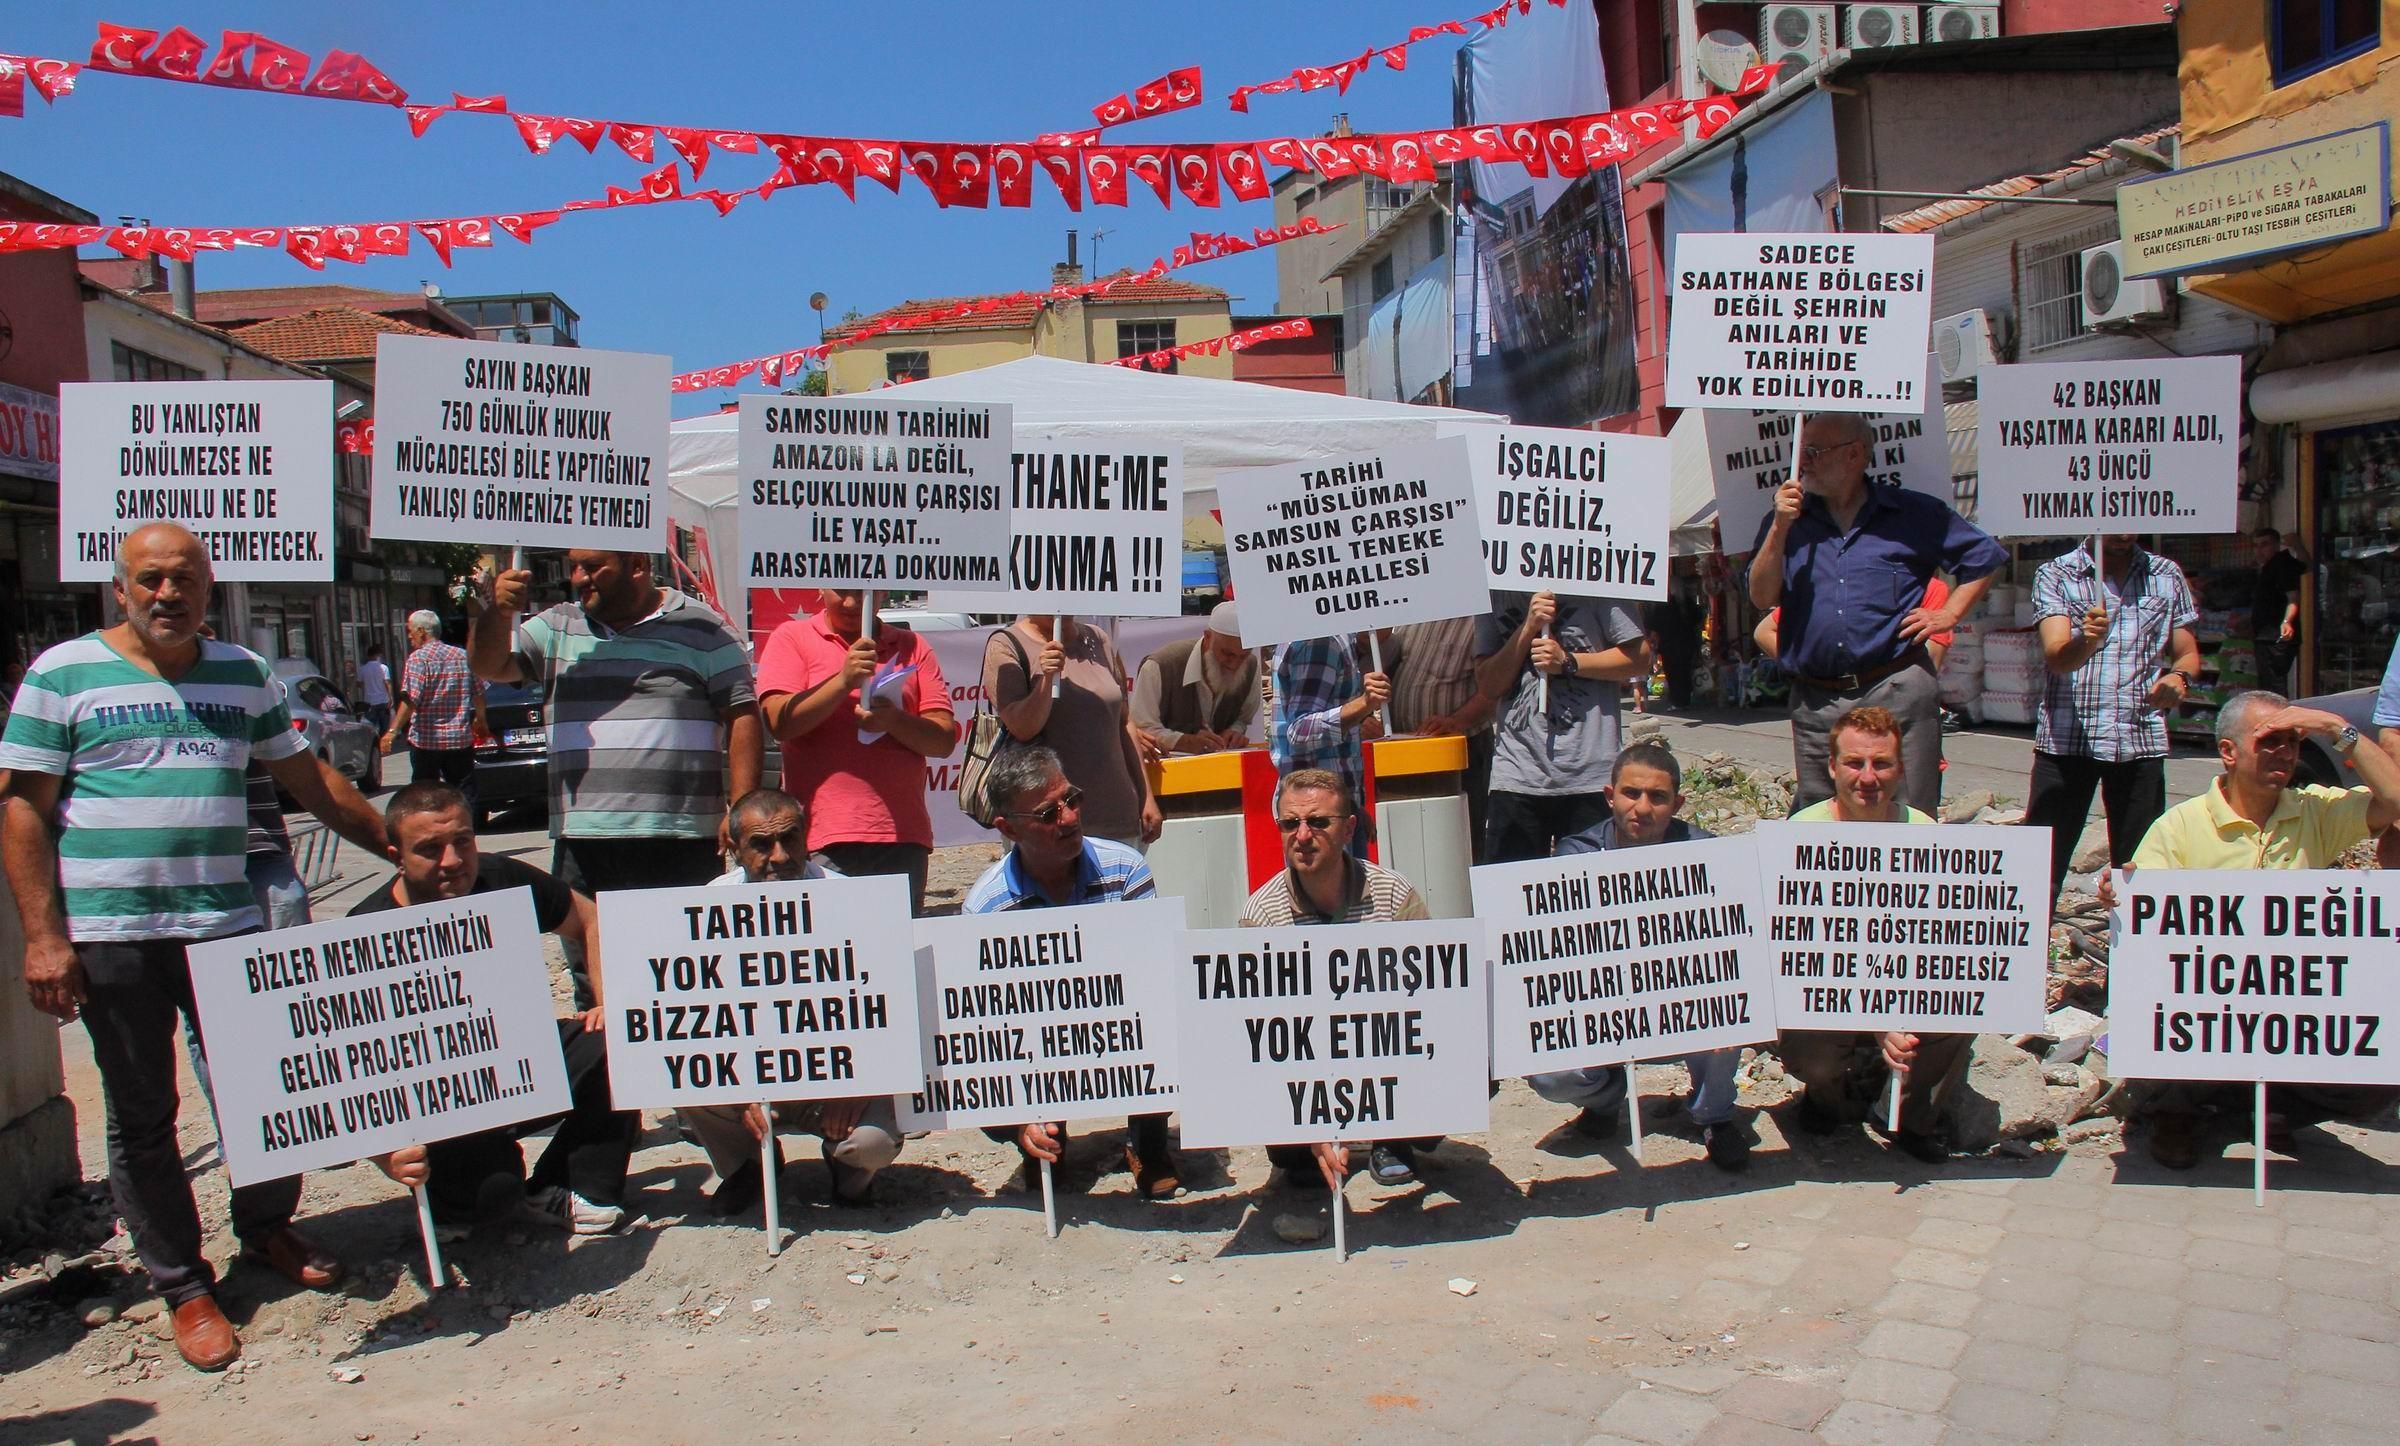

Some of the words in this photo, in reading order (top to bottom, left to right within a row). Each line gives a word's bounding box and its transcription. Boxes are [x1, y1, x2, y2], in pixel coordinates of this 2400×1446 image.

[2134, 229, 2163, 243] HESAP
[2251, 208, 2262, 219] ve
[2304, 184, 2367, 207] TABAKALARI
[1759, 245, 1855, 265] SADECE
[2143, 244, 2165, 259] ÇAKI
[2241, 224, 2263, 237] TAŞI
[1681, 271, 1809, 291] SAATHANE
[1818, 268, 1924, 292] BÖLGESİ
[1714, 293, 1784, 317] DEĞİL
[1793, 294, 1886, 320] ŞEHRİN
[1727, 323, 1828, 344] ANILARI
[1839, 325, 1868, 345] VE
[464, 357, 516, 392] SAYIN
[522, 362, 591, 398] BAŞKAN
[1744, 347, 1857, 372] TARİHİDE
[1697, 376, 1743, 396] YOK
[1752, 373, 1912, 401] EDİLİYOR...!!
[2053, 381, 2076, 408] 42
[2084, 378, 2161, 410] BAŞKAN
[132, 404, 155, 435] BU
[161, 402, 260, 437] YANLIŞTAN
[441, 400, 473, 432] 750
[479, 397, 549, 437] GÜNLÜK
[554, 407, 612, 442] HUKUK
[765, 406, 889, 436] SAMSUNUN
[896, 406, 990, 439] TARİHİNİ
[1999, 418, 2087, 450] YAŞATMA
[2095, 416, 2165, 444] KARARI
[2172, 414, 2223, 445] ALDI,
[120, 440, 241, 477] DÖNÜLMEZSE
[248, 445, 273, 476] NE
[396, 435, 507, 478] MÜCADELESİ
[513, 442, 551, 480] BİLE
[557, 448, 651, 487] YAPTIĞINIZ
[773, 443, 864, 472] AMAZON
[907, 442, 974, 478] DEĞİL,
[1300, 457, 1384, 491] TARİHİ
[1497, 433, 1606, 483] İŞGALCİ
[1726, 441, 1782, 471] MİLLİ
[1885, 443, 1905, 466] Kİ
[2068, 455, 2090, 482] 43
[2098, 448, 2151, 481] ÜNCÜ
[116, 488, 215, 520] SAMSUNLU
[223, 488, 247, 519] NE
[254, 488, 277, 519] DE
[398, 484, 467, 523] YANLIŞI
[473, 483, 574, 525] GÖRMENİZE
[579, 493, 651, 530] YETMEDİ
[752, 479, 907, 510] SELÇUKLUNUN
[916, 483, 1000, 514] ÇARŞISI
[1497, 485, 1611, 538] DEĞİLİZ,
[2022, 491, 2094, 519] YIKMAK
[2101, 485, 2196, 518] İSTİYOR...
[812, 511, 844, 543] İLE
[851, 517, 940, 548] YAŞAT...
[1234, 518, 1342, 553] SAMSUN
[1266, 545, 1341, 573] NASIL
[1348, 528, 1445, 560] TENEKE
[750, 551, 887, 580] ARASTAMIZA
[895, 554, 1001, 582] DOKUNMA
[1132, 536, 1163, 593] !!!
[1287, 552, 1430, 595] MAHALLESİ
[1519, 538, 1656, 587] SAHİBİYİZ
[1315, 589, 1409, 616] OLUR...
[1795, 840, 1882, 872] MAĞDUR
[1890, 843, 2003, 875] ETMİYORUZ
[1522, 870, 1592, 917] TARİHİ
[1597, 862, 1716, 907] BIRAKALIM,
[1778, 874, 1824, 906] İHYA
[1831, 876, 1930, 909] EDİYORUZ
[1937, 879, 2024, 915] DEDİNİZ,
[683, 892, 813, 941] TARİHİ
[1502, 918, 1631, 966] ANILARIMIZI
[1637, 903, 1753, 948] BIRAKALIM,
[1771, 915, 1814, 942] HEM
[1822, 916, 1859, 943] YER
[1867, 913, 2030, 947] GÖSTERMEDİNİZ
[2131, 894, 2245, 936] PARK
[244, 946, 319, 994] BİZLER
[322, 909, 494, 980] MEMLEKETİMİZİN
[648, 954, 724, 993] YOK
[739, 939, 869, 988] EDENİ,
[979, 923, 1082, 971] ADALETLİ
[1781, 951, 1824, 977] HEM
[1832, 952, 1858, 978] DE
[1866, 953, 1908, 980] %40
[1915, 951, 2010, 982] BEDELSİZ
[1192, 940, 1312, 1000] TARİHİ
[1328, 943, 1469, 1001] ÇARŞIYI
[1523, 964, 1624, 1008] TAPULARI
[1630, 949, 1740, 994] BIRAKALIM
[2169, 944, 2349, 997] TİCARET
[288, 986, 386, 1039] DÜŞMANI
[388, 965, 473, 1019] DEĞİLİZ,
[625, 999, 758, 1043] BİZZAT
[773, 988, 888, 1034] TARİH
[944, 973, 1124, 1020] DAVRANIYORUM
[1803, 987, 1852, 1013] TERK
[1859, 988, 1985, 1016] YAPTIRDINIZ
[933, 1022, 1033, 1067] DEDİNİZ,
[1041, 1011, 1144, 1059] HEMŞERİ
[1244, 1015, 1316, 1063] YOK
[1329, 1010, 1435, 1061] ETME,
[1529, 1009, 1578, 1053] PEKİ
[1584, 1006, 1652, 1046] BAŞKA
[1659, 992, 1751, 1036] ARZUNUZ
[2153, 1002, 2380, 1057] İSTİYORUZ
[280, 1042, 343, 1094] GELİN
[345, 1021, 432, 1080] PROJEYİ
[433, 1007, 499, 1061] TARİHİ
[663, 1052, 741, 1090] YOK
[755, 1045, 854, 1085] EDER
[261, 1101, 339, 1153] ASLINA
[340, 1085, 411, 1134] UYGUN
[412, 1058, 535, 1117] YAPALIM...!!
[1286, 1076, 1398, 1130] YAŞAT
